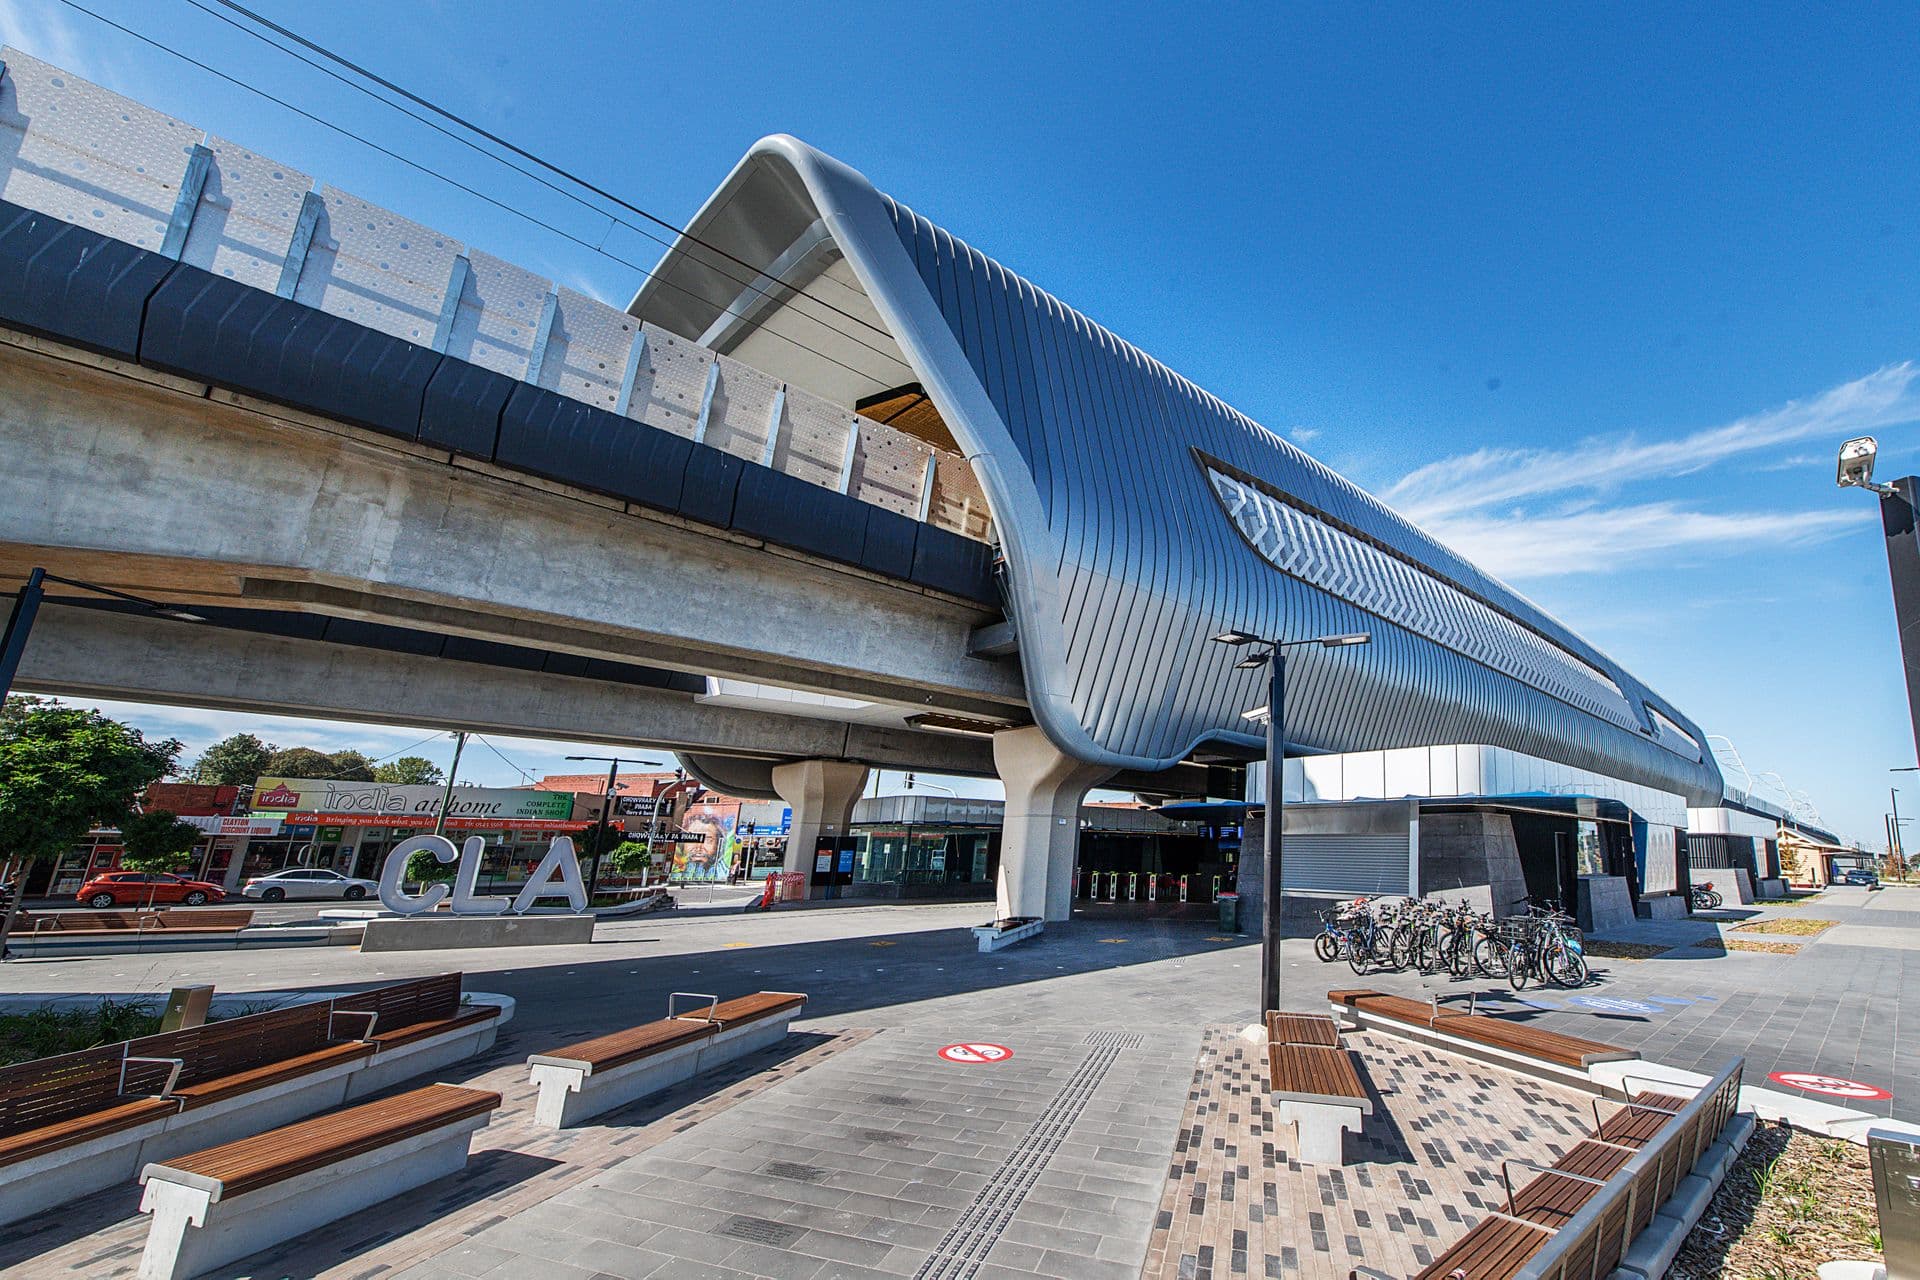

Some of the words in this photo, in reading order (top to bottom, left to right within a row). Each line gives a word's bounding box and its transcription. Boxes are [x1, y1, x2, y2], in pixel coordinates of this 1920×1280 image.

[262, 792, 297, 803] india
[323, 782, 408, 811] india
[414, 798, 441, 812] at
[447, 794, 502, 814] home
[526, 800, 566, 809] COMPLETE
[516, 808, 543, 816] INDIAN
[545, 809, 565, 817] SHOP
[222, 817, 249, 826] CLAYTON
[325, 816, 357, 826] Bringing
[374, 816, 389, 825] back
[391, 817, 408, 826] what
[424, 818, 436, 827] left
[220, 826, 250, 834] DISCOUNT
[250, 827, 273, 835] LIQUOR
[378, 833, 589, 916] CLA
